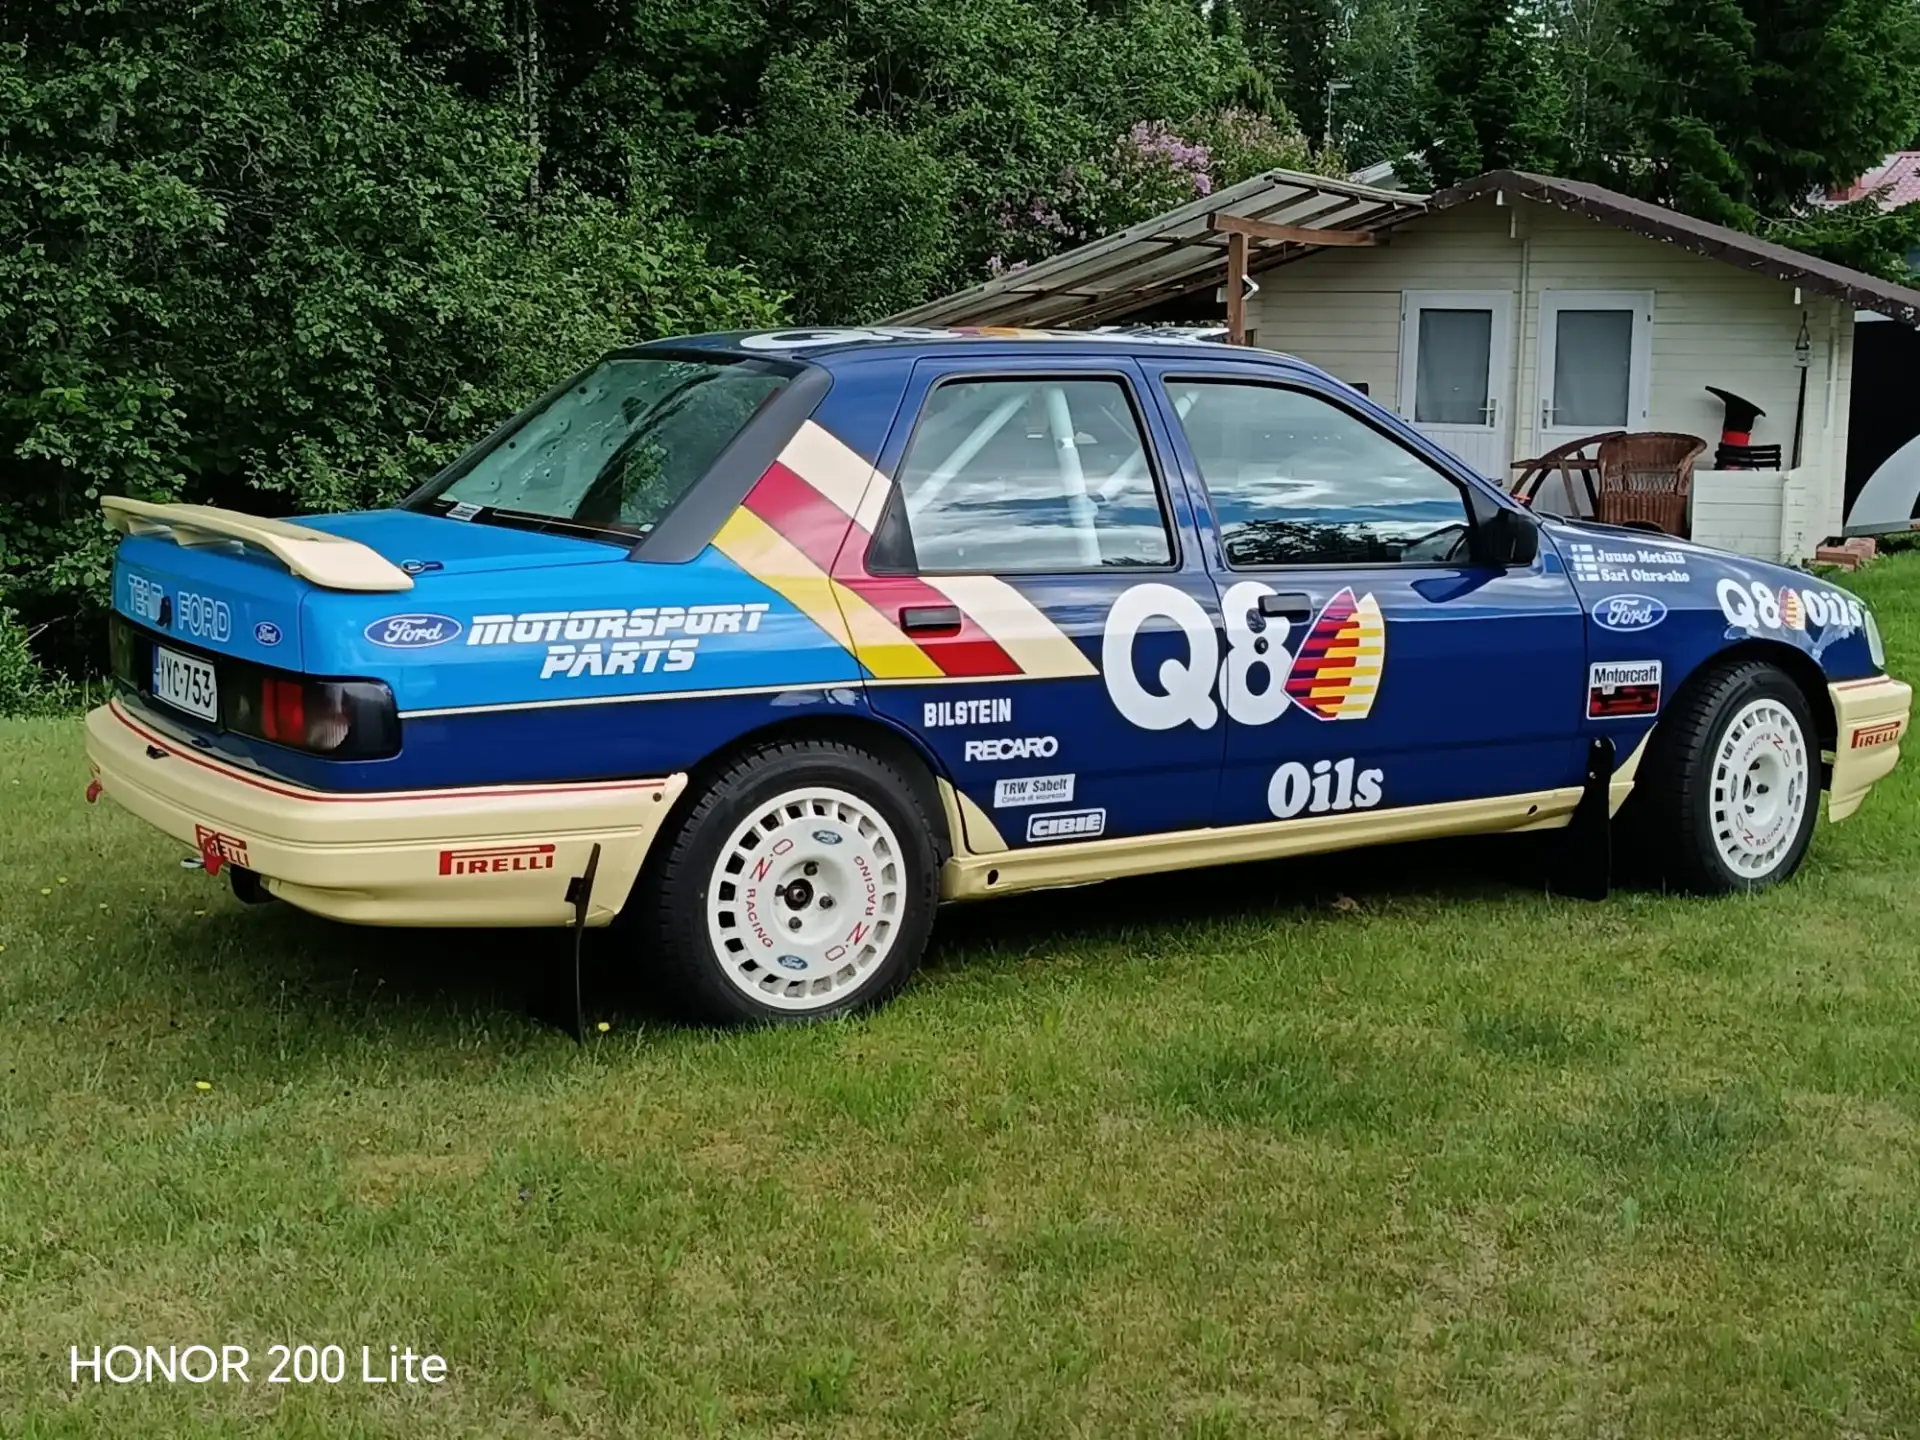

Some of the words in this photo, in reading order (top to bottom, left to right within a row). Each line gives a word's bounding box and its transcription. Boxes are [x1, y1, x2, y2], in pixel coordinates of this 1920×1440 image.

[1597, 549, 1636, 563] Juuso
[1600, 568, 1629, 582] Sari
[1631, 568, 1690, 583] Ohra-aho
[178, 591, 231, 643] FORD
[1607, 599, 1653, 626] Ford
[1716, 578, 1782, 630] Q8
[1801, 589, 1862, 627] Oils
[258, 624, 277, 643] Ford
[383, 618, 443, 643] Ford
[466, 603, 770, 646] MOTORSPORT
[540, 638, 700, 679] PARTS
[1102, 581, 1296, 731] Q8
[1594, 665, 1658, 685] Motorcraft
[923, 698, 1012, 728] BILSTEIN
[965, 736, 1059, 762] RECARO
[1851, 720, 1901, 749] PIRELLI
[1003, 781, 1028, 795] TRW
[1032, 778, 1067, 792] Sabelt
[1267, 757, 1384, 819] Oils
[439, 844, 556, 876] PIRELLI
[853, 855, 877, 916] RACING
[747, 888, 774, 948] RACING
